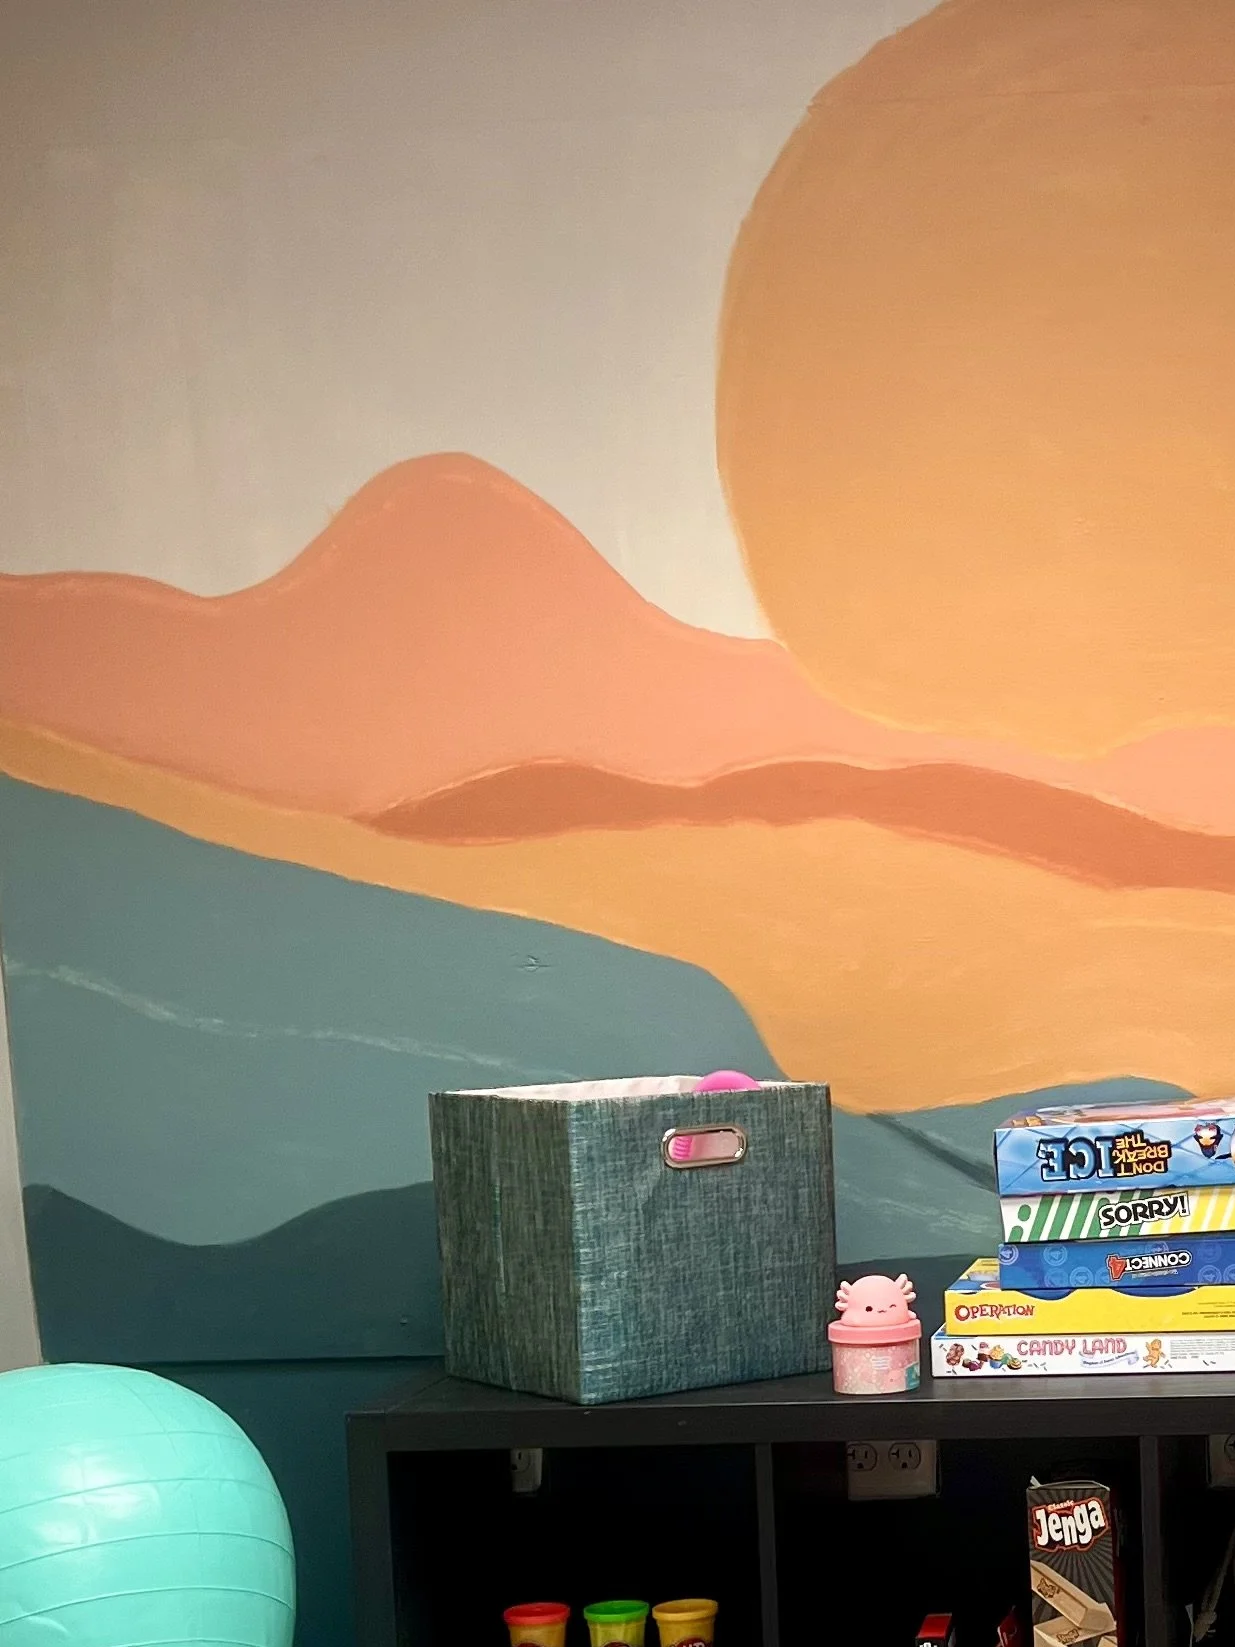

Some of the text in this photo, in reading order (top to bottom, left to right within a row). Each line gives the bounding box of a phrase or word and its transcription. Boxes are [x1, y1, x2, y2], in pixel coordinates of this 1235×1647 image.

[1115, 1133, 1147, 1149] THE
[1037, 1137, 1114, 1182] ICE
[1112, 1144, 1169, 1164] BREAK
[1100, 1194, 1188, 1228] SORRY!
[1124, 1252, 1190, 1271] CONNECT
[954, 1303, 1035, 1322] OPERATION
[1016, 1337, 1128, 1357] CANDY LAND
[1035, 1500, 1106, 1546] Jenga
